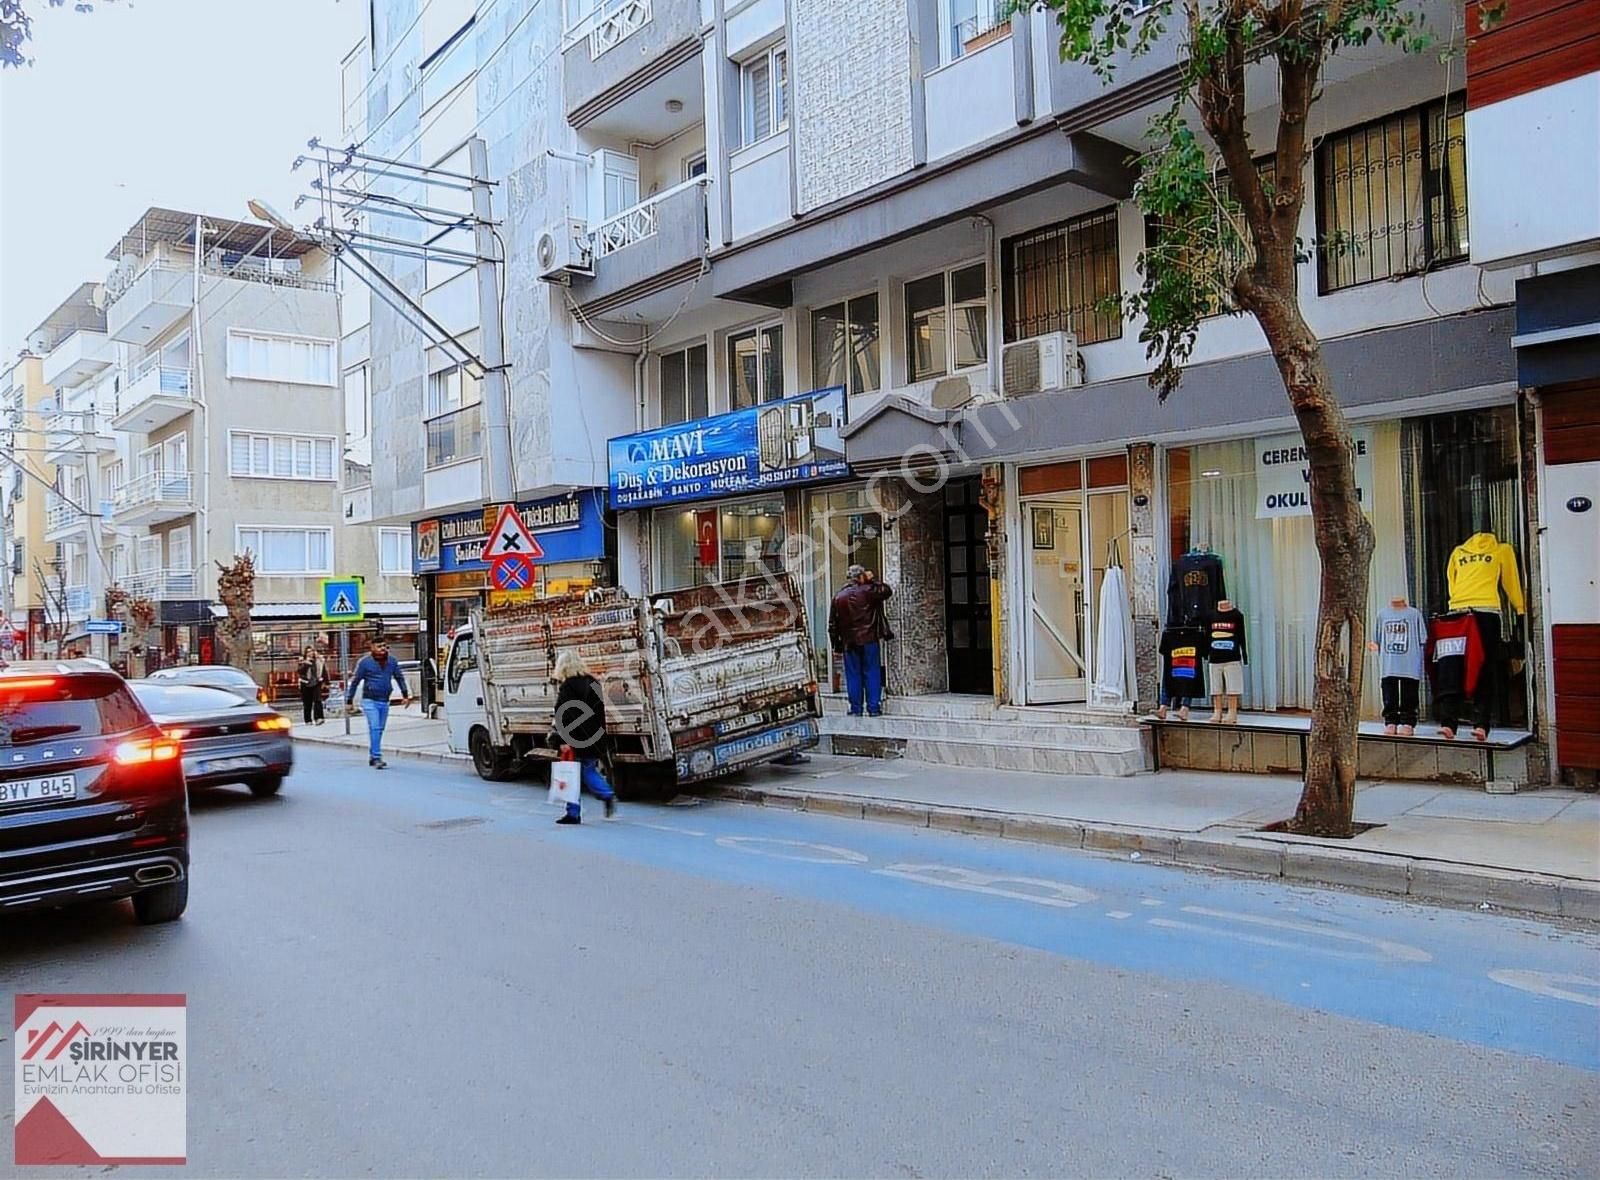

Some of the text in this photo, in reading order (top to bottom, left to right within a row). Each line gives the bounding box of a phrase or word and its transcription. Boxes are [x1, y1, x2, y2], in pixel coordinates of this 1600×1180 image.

[651, 424, 705, 462] MAVİ
[617, 455, 747, 491] Duş & Dekorasyon
[1301, 468, 1312, 483] V
[671, 482, 701, 495] BANYO
[40, 778, 72, 796] 845
